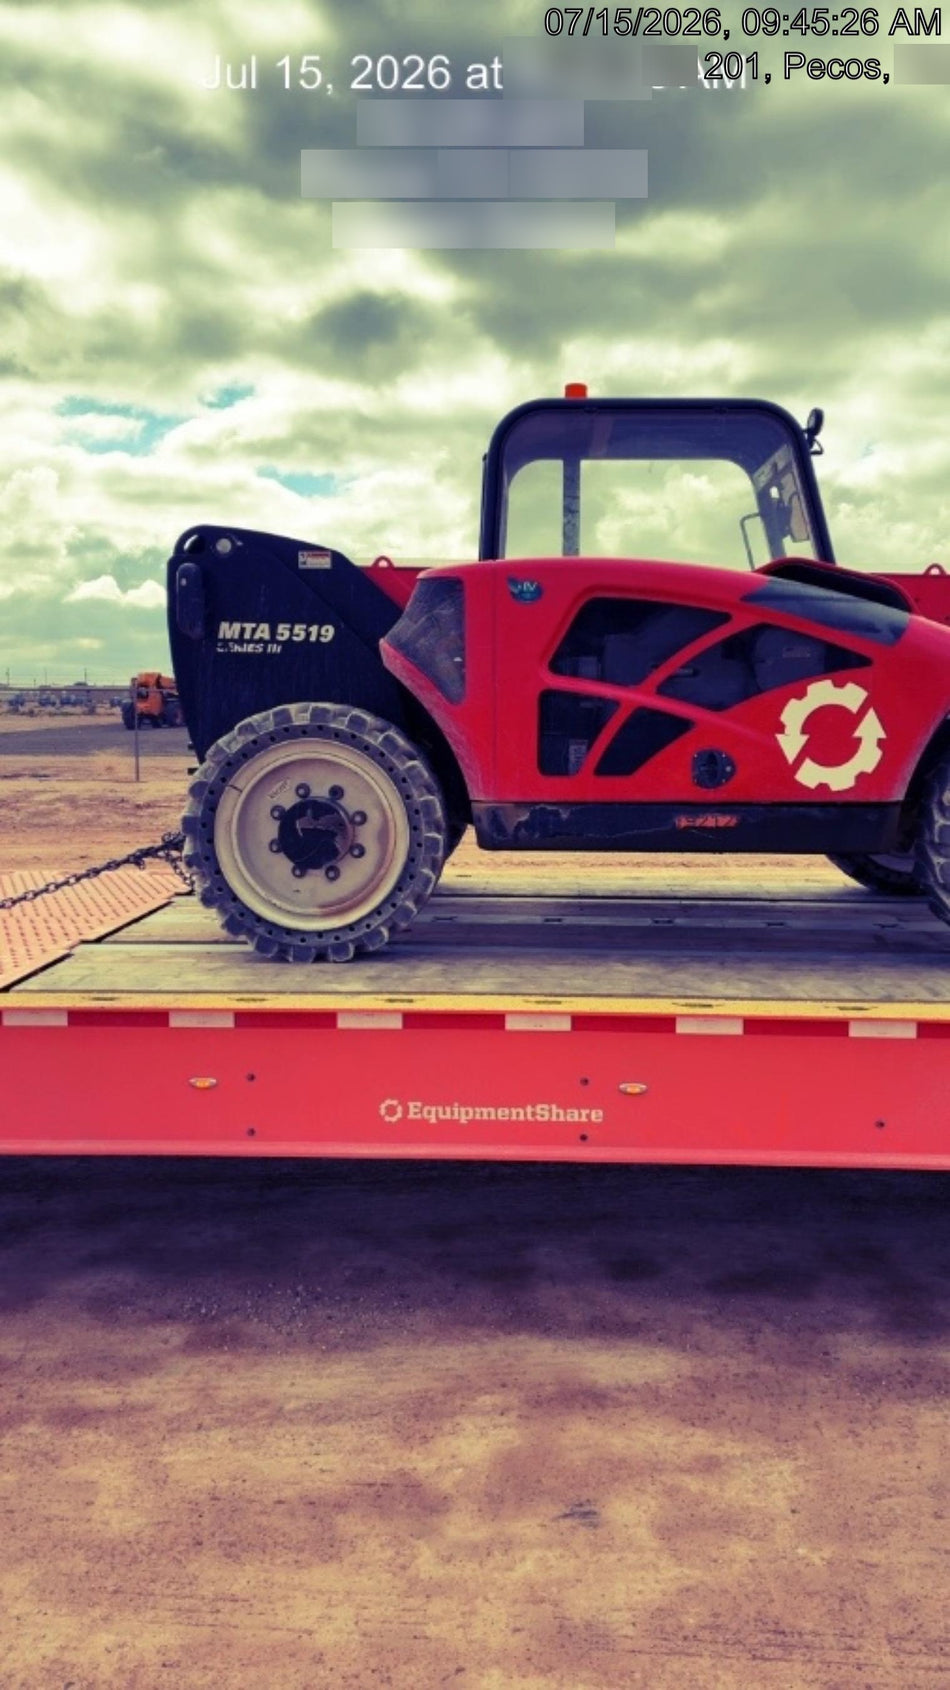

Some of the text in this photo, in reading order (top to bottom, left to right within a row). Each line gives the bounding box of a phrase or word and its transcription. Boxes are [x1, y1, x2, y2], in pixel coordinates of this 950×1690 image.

[218, 621, 335, 643] MTA 5519
[406, 1100, 604, 1123] EquipmentShare
